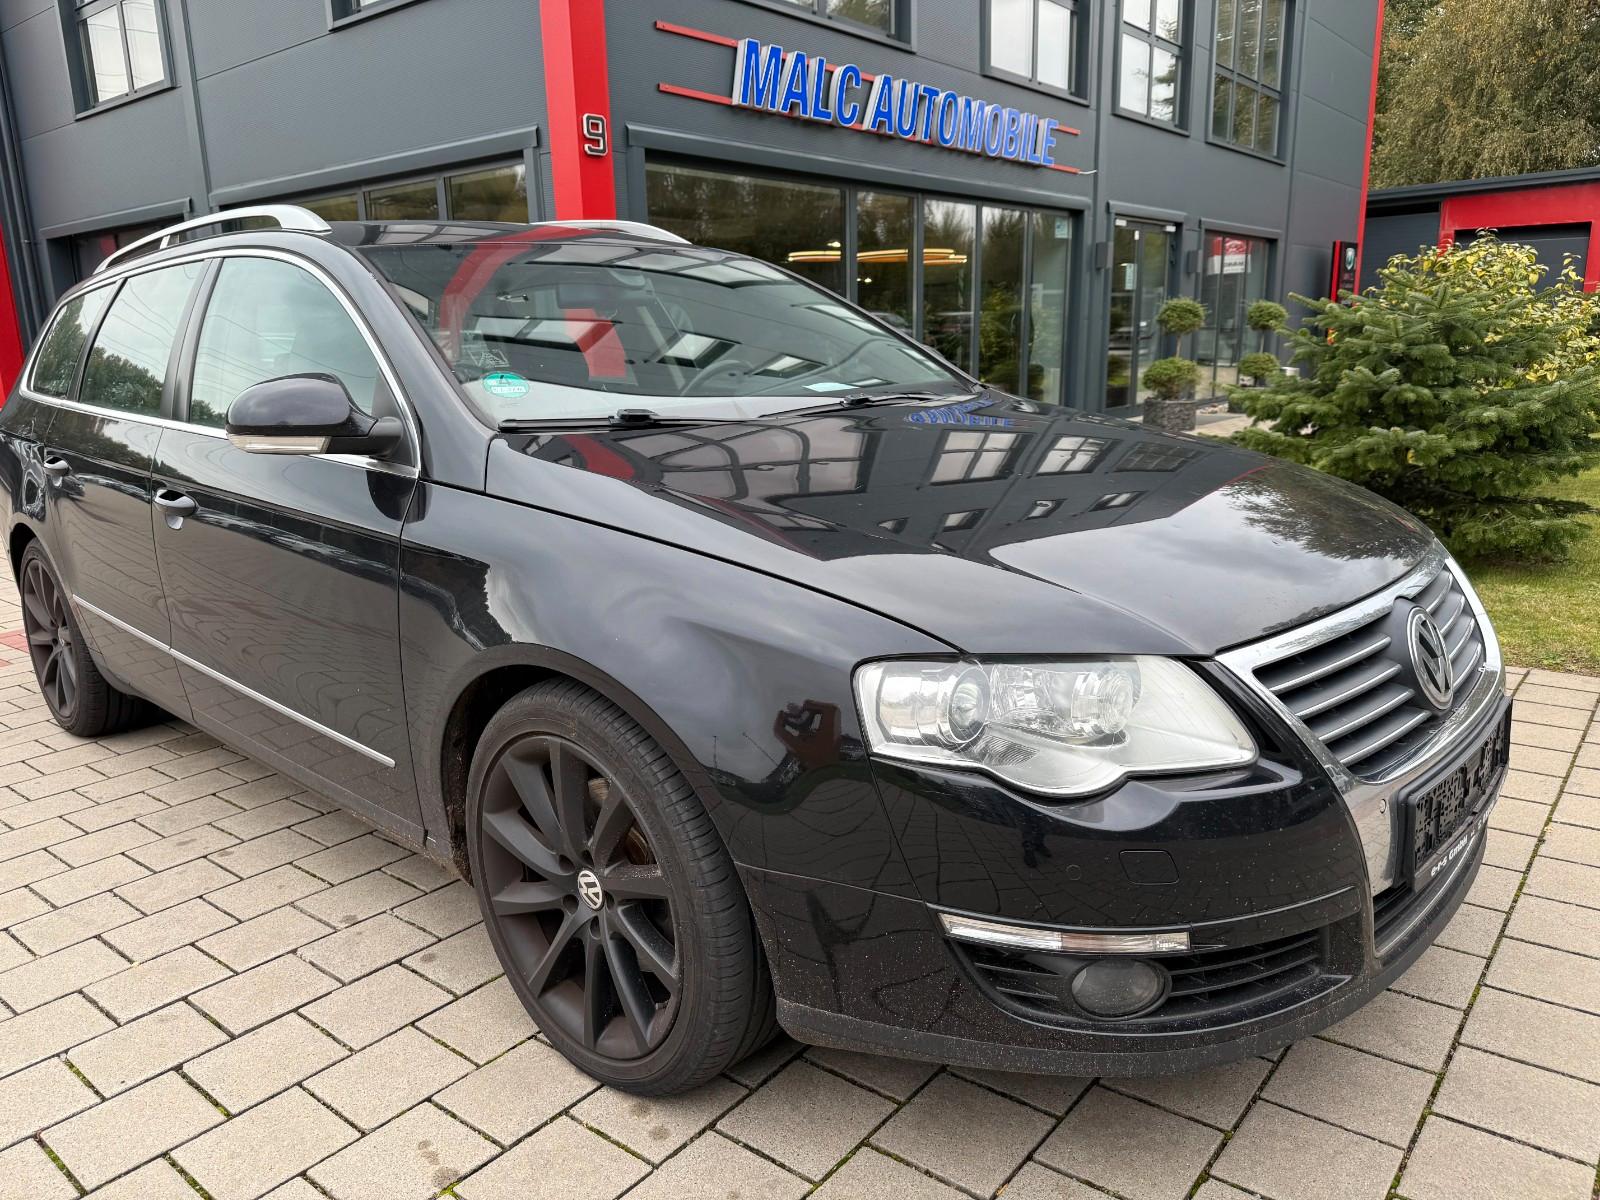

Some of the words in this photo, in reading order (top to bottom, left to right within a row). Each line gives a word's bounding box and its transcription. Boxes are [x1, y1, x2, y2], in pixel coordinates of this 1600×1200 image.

[582, 112, 608, 156] 9
[735, 37, 863, 128] MALC
[867, 74, 1060, 167] AUTOMOBILE
